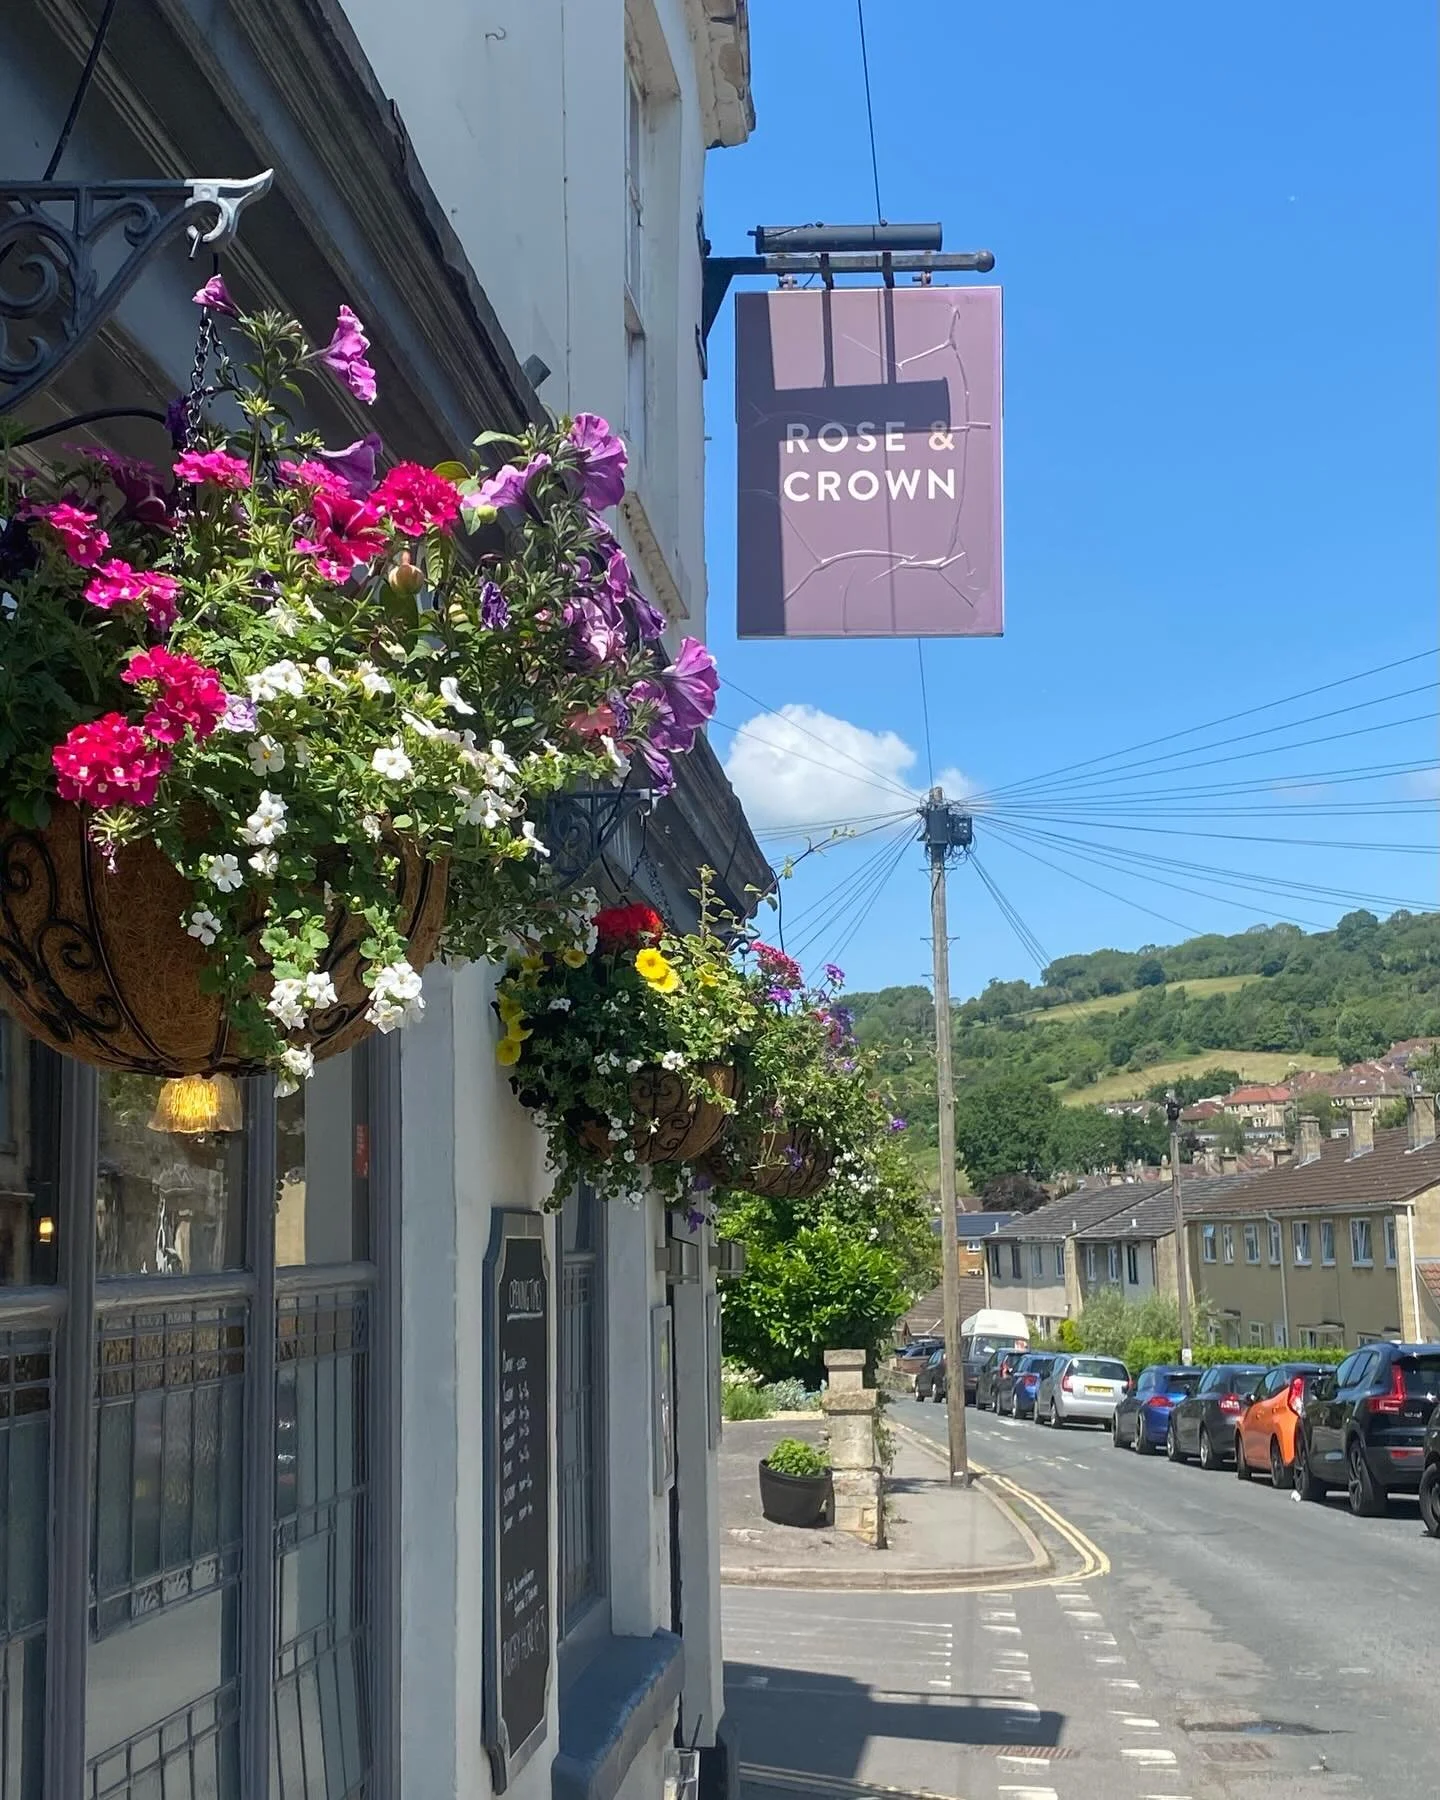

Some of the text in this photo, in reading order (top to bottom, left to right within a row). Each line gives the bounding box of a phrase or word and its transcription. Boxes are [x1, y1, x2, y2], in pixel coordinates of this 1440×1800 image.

[785, 420, 955, 453] ROSE &
[783, 469, 956, 501] CROWN
